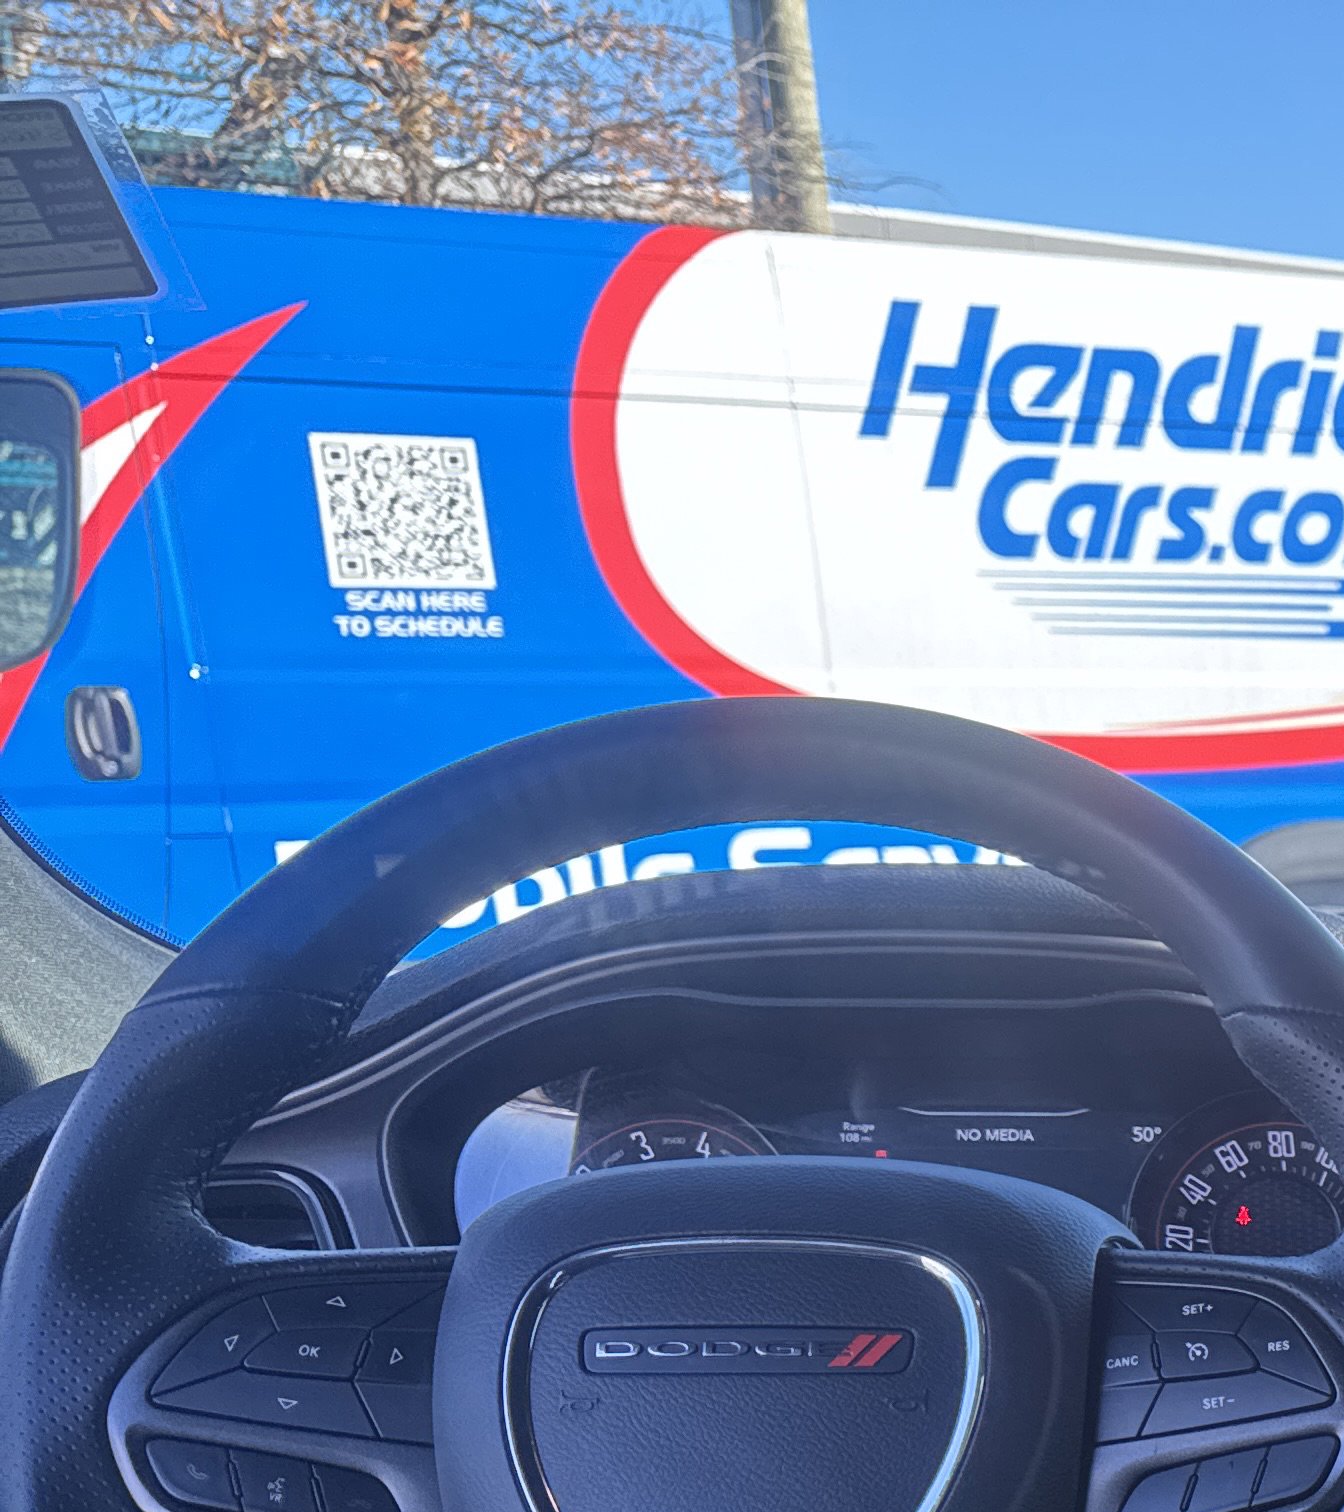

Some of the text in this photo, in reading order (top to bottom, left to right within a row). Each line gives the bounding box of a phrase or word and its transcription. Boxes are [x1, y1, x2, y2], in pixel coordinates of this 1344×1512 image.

[344, 589, 488, 613] SCAN HERE
[332, 614, 505, 638] TO SCHEDULE
[842, 1121, 876, 1134] Range
[956, 1128, 1035, 1142] NO MEDIA
[628, 1130, 655, 1161] 3
[695, 1130, 712, 1160] 4
[840, 1132, 861, 1144] 108
[1247, 1141, 1262, 1151] 70
[1266, 1130, 1296, 1158] 80
[1213, 1140, 1249, 1173] 60
[1179, 1173, 1213, 1205] 40
[1165, 1223, 1194, 1252] 20
[1182, 1302, 1214, 1316] SET+
[298, 1344, 321, 1358] OK
[595, 1340, 854, 1358] DODGE
[1267, 1340, 1291, 1352] RES
[1106, 1355, 1140, 1370] CANC
